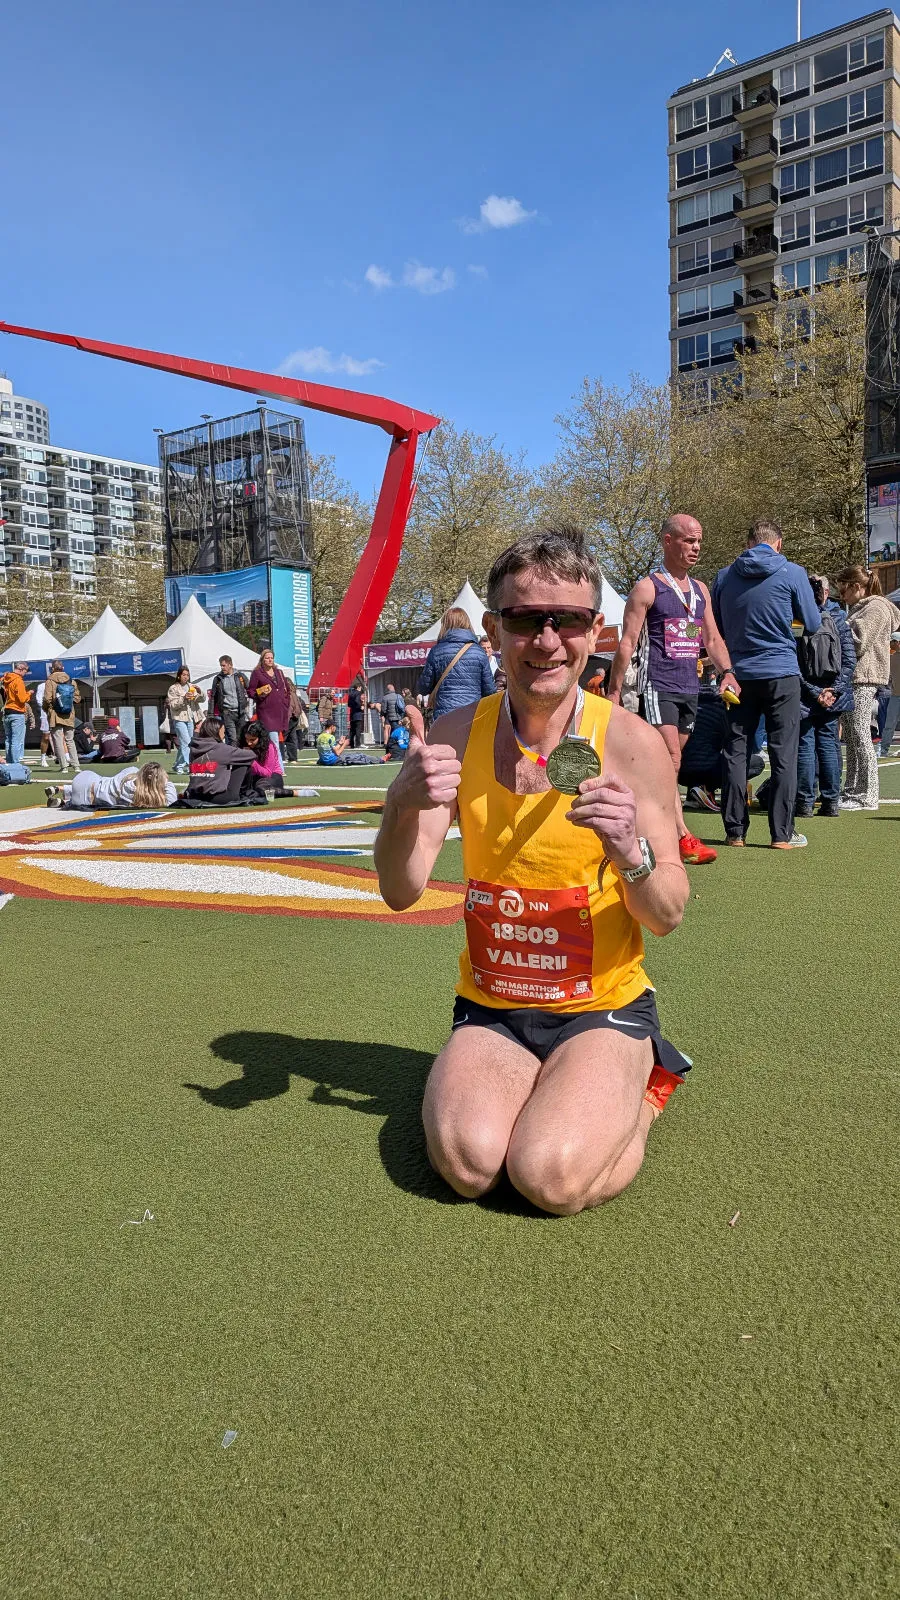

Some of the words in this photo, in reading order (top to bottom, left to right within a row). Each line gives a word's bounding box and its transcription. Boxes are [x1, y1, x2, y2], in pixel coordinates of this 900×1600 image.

[293, 571, 311, 676] SCHOUWBURGPLEIN
[394, 647, 432, 660] MASS
[471, 891, 476, 899] F
[477, 893, 490, 902] 277
[529, 901, 549, 912] NN
[490, 922, 559, 945] 18509
[486, 947, 568, 971] VALERII
[490, 984, 544, 999] ROTTERDAM
[544, 990, 566, 1000] 2026
[495, 979, 508, 988] NN
[508, 981, 560, 993] MARATHON
